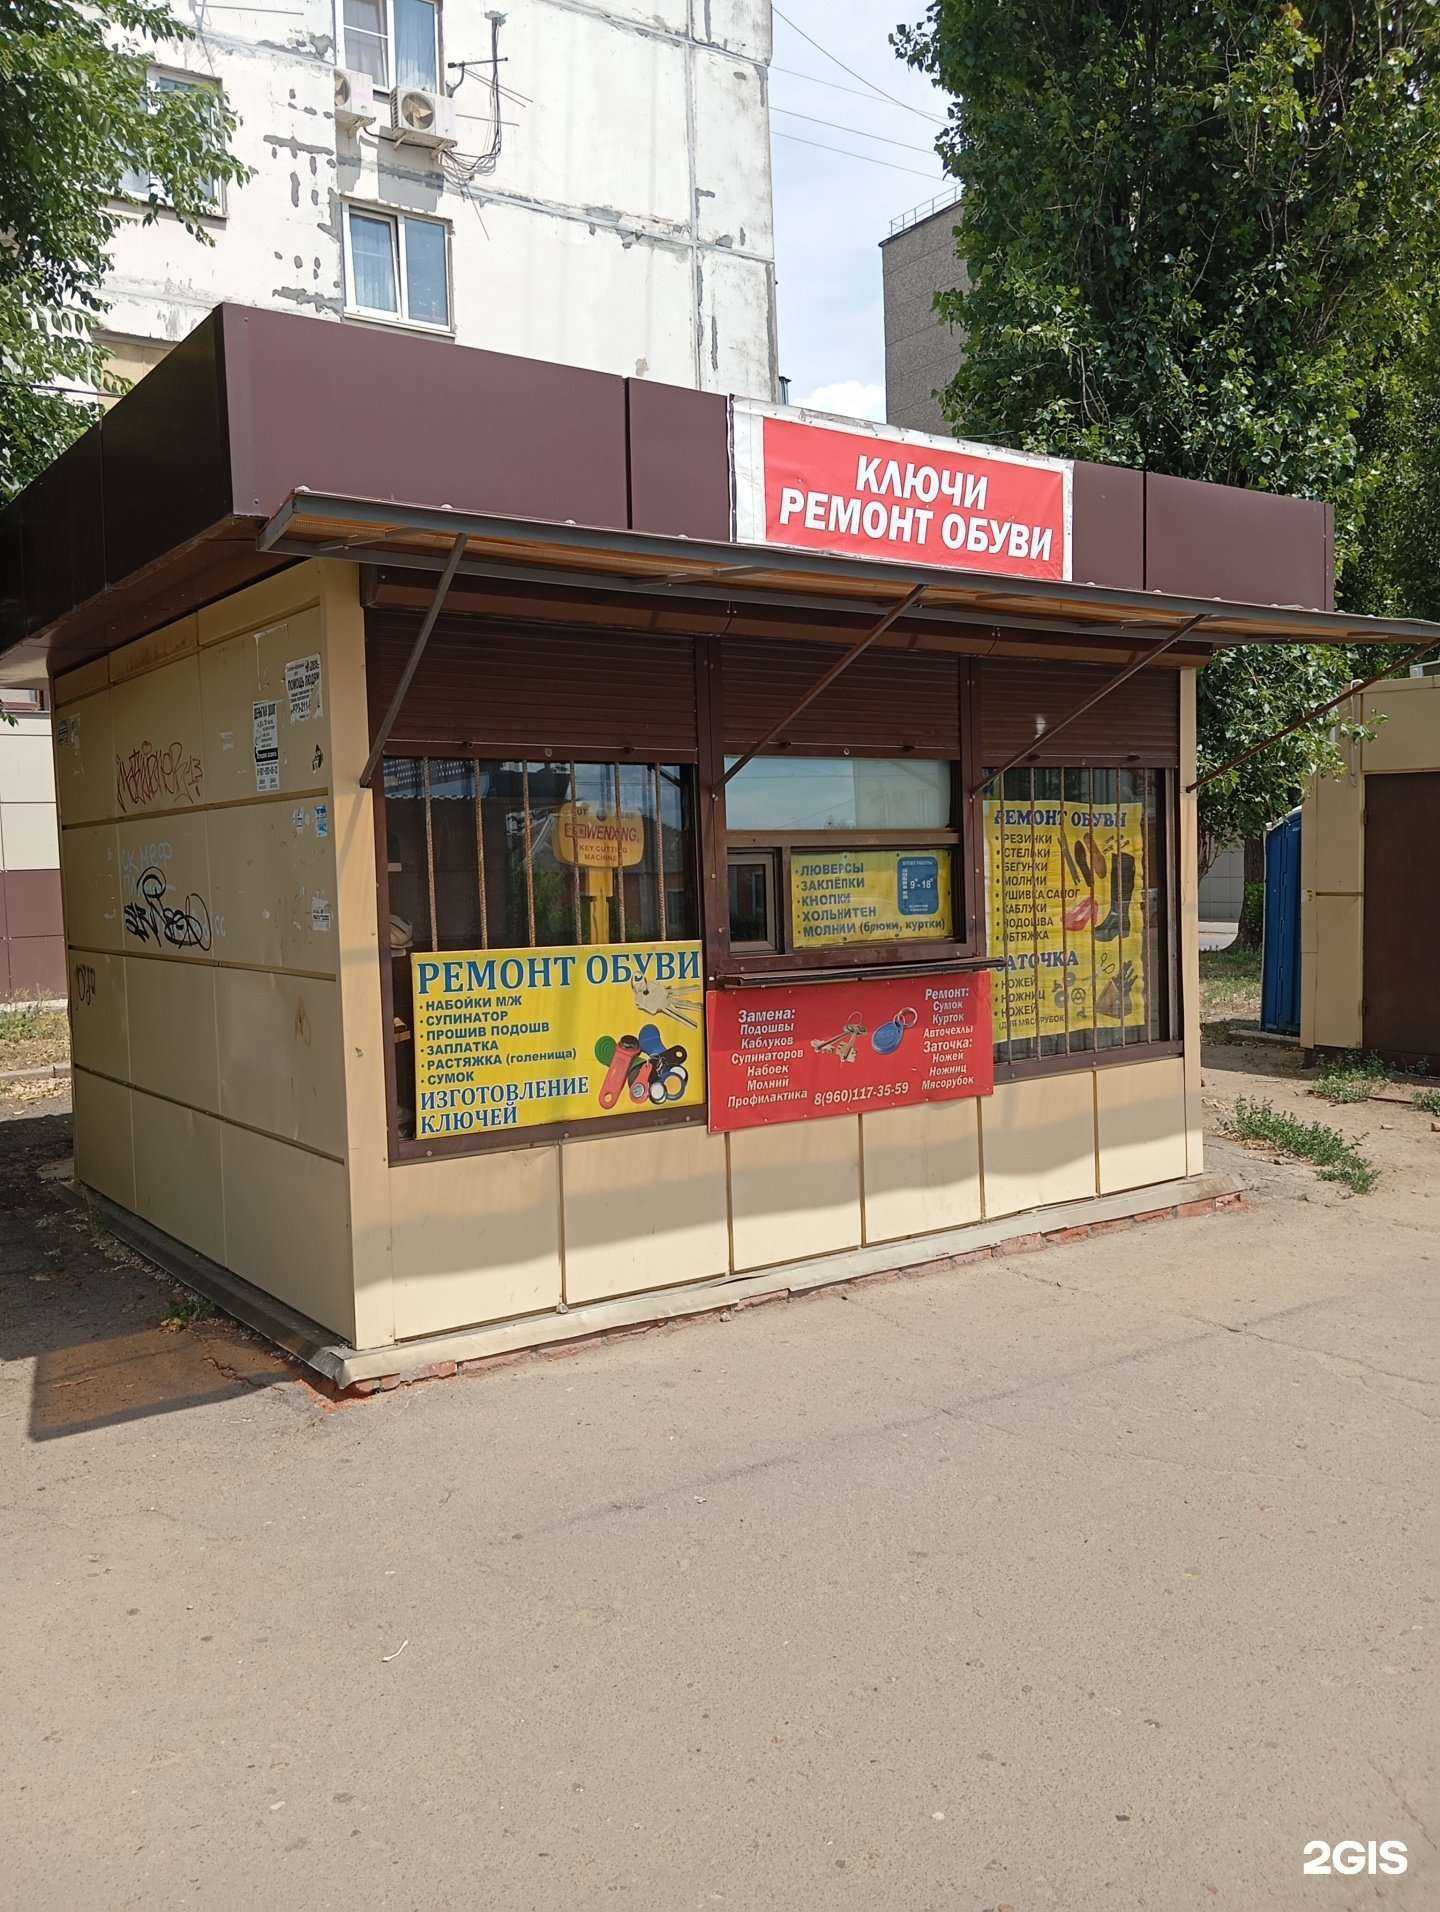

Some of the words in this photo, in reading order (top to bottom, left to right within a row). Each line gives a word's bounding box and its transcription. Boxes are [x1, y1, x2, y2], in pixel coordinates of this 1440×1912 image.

[856, 454, 989, 510] КЛЮЧИ
[779, 488, 934, 544] РЕМОНТ
[942, 513, 1053, 561] ОБУВИ
[801, 863, 864, 876] ЛЮВЕРСЫ
[801, 876, 865, 891] ЗАКЛЁПКИ
[801, 892, 851, 906] КНОПКИ
[802, 907, 876, 922] ХОЛЬНИТЕН
[803, 922, 856, 937] МОЛНИИ
[860, 921, 902, 935] (брюки,
[905, 918, 945, 931] куртки)
[417, 956, 576, 994] РЕМОНТ
[586, 951, 700, 984] ОБУВИ
[925, 987, 969, 1000] Ремонт:
[426, 996, 491, 1011] НАБОЙКИ
[496, 995, 522, 1007] М/Ж
[933, 1000, 963, 1012] Сумок
[426, 1011, 508, 1026] СУПИНАТОР
[738, 1008, 796, 1022] Замена:
[932, 1013, 964, 1025] Курток
[427, 1027, 486, 1041] ПРОШИВ
[491, 1022, 550, 1037] ПОДОШВ
[740, 1023, 794, 1036] Подошвы
[923, 1025, 973, 1039] Авточехлы
[427, 1040, 499, 1056] ЗАПЛАТКА
[741, 1036, 794, 1049] Каблуков
[923, 1037, 973, 1053] Заточка:
[427, 1054, 502, 1070] РАСТЯЖКА
[506, 1048, 577, 1065] (голенища)
[731, 1049, 804, 1066] Супинаторов
[932, 1052, 964, 1062] Ножей
[747, 1064, 789, 1077] Набоек
[929, 1063, 967, 1077] Ножниц
[428, 1072, 474, 1085] СУМОК
[747, 1076, 789, 1091] Молний
[922, 1076, 974, 1091] Мясорубок
[421, 1076, 589, 1110] ИЗГОТОВЛЕНИЕ
[728, 1090, 808, 1108] Профилактика
[814, 1082, 909, 1106] 8(960)117-35-59
[421, 1102, 517, 1134] КЛЮЧЕЙ
